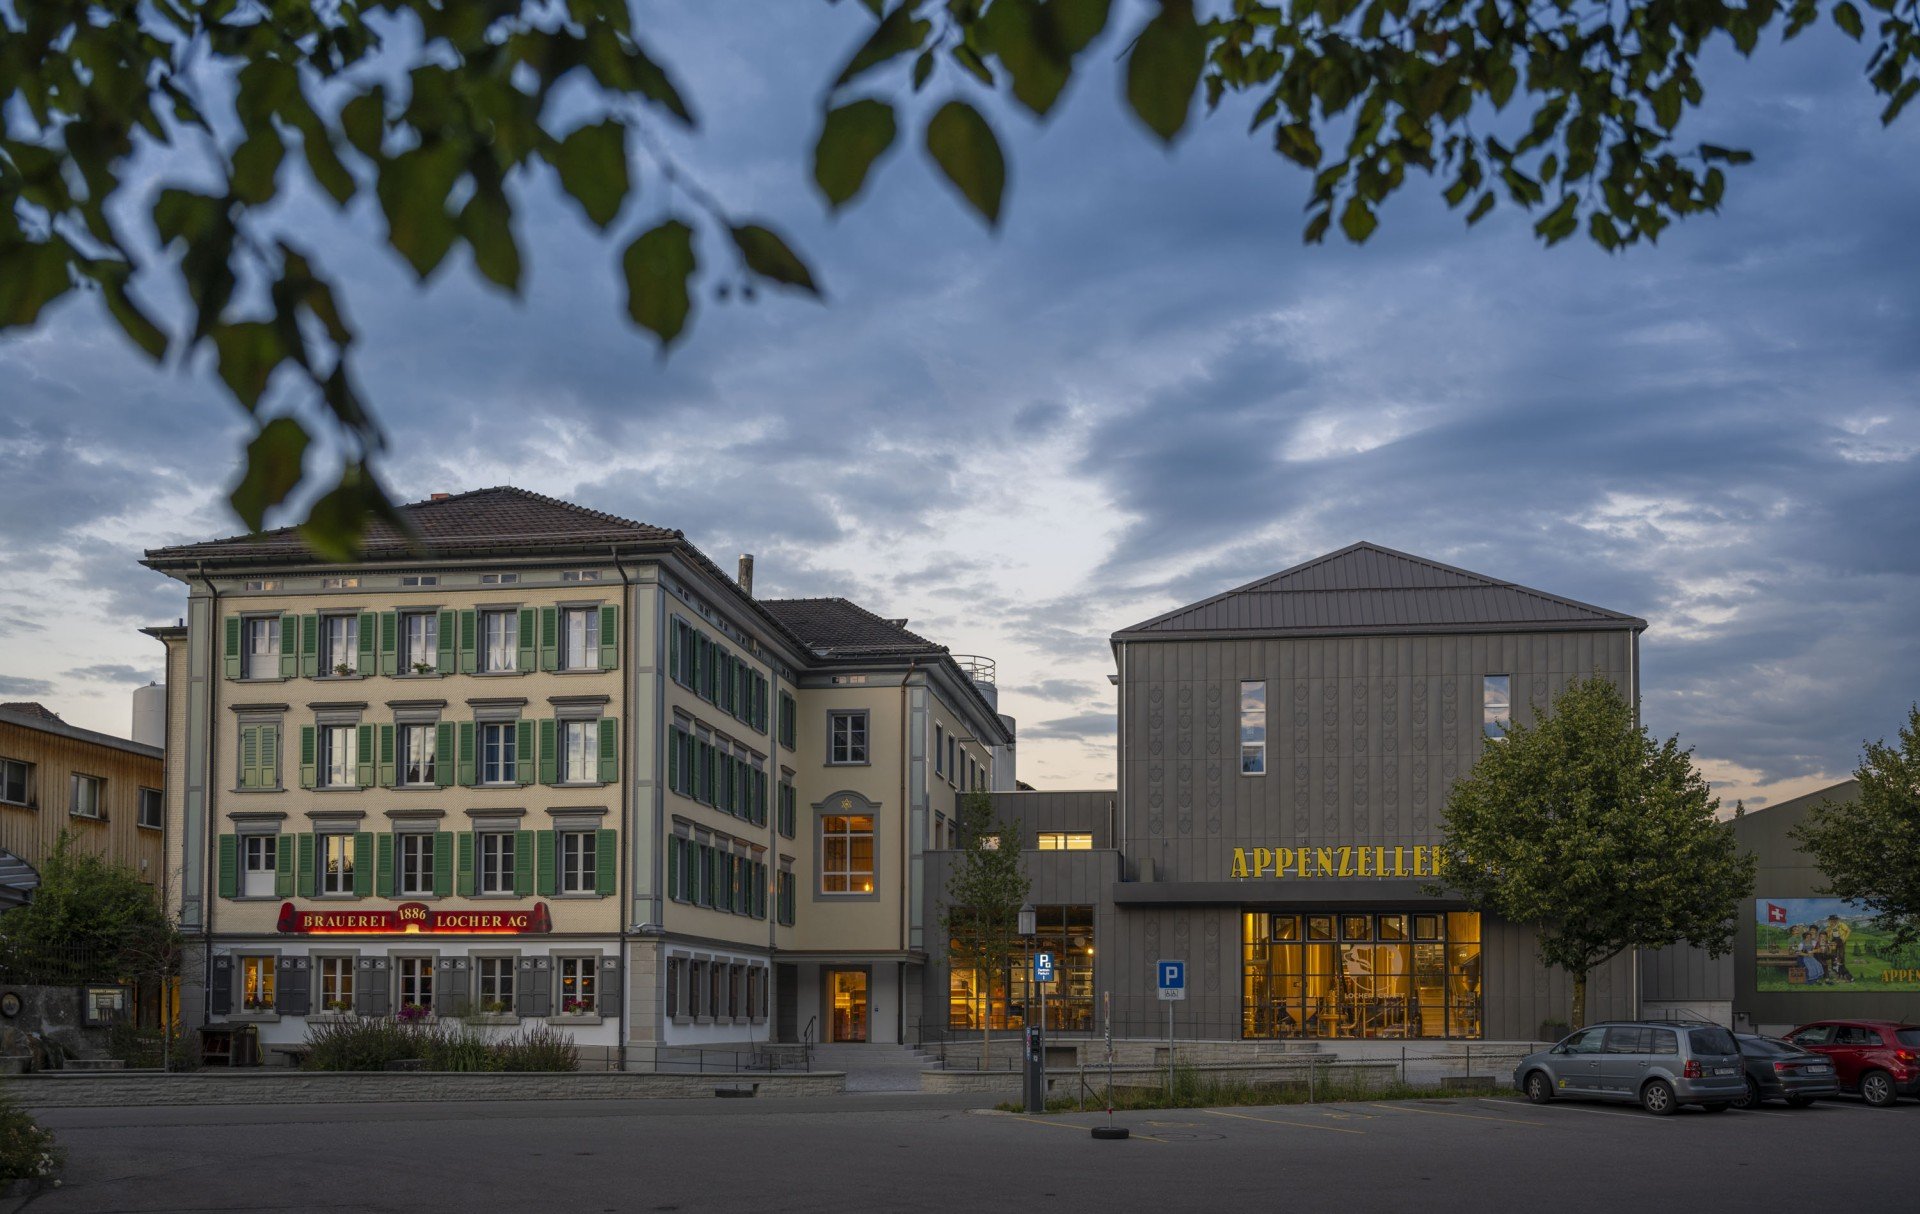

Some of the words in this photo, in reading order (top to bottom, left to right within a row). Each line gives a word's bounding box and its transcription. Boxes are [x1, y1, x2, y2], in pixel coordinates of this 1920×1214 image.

[399, 907, 427, 921] 1886
[303, 915, 386, 927] BRAUEREI
[437, 915, 502, 927] LOCHER
[507, 915, 527, 927] AG
[1039, 954, 1049, 967] P
[1165, 966, 1178, 985] P
